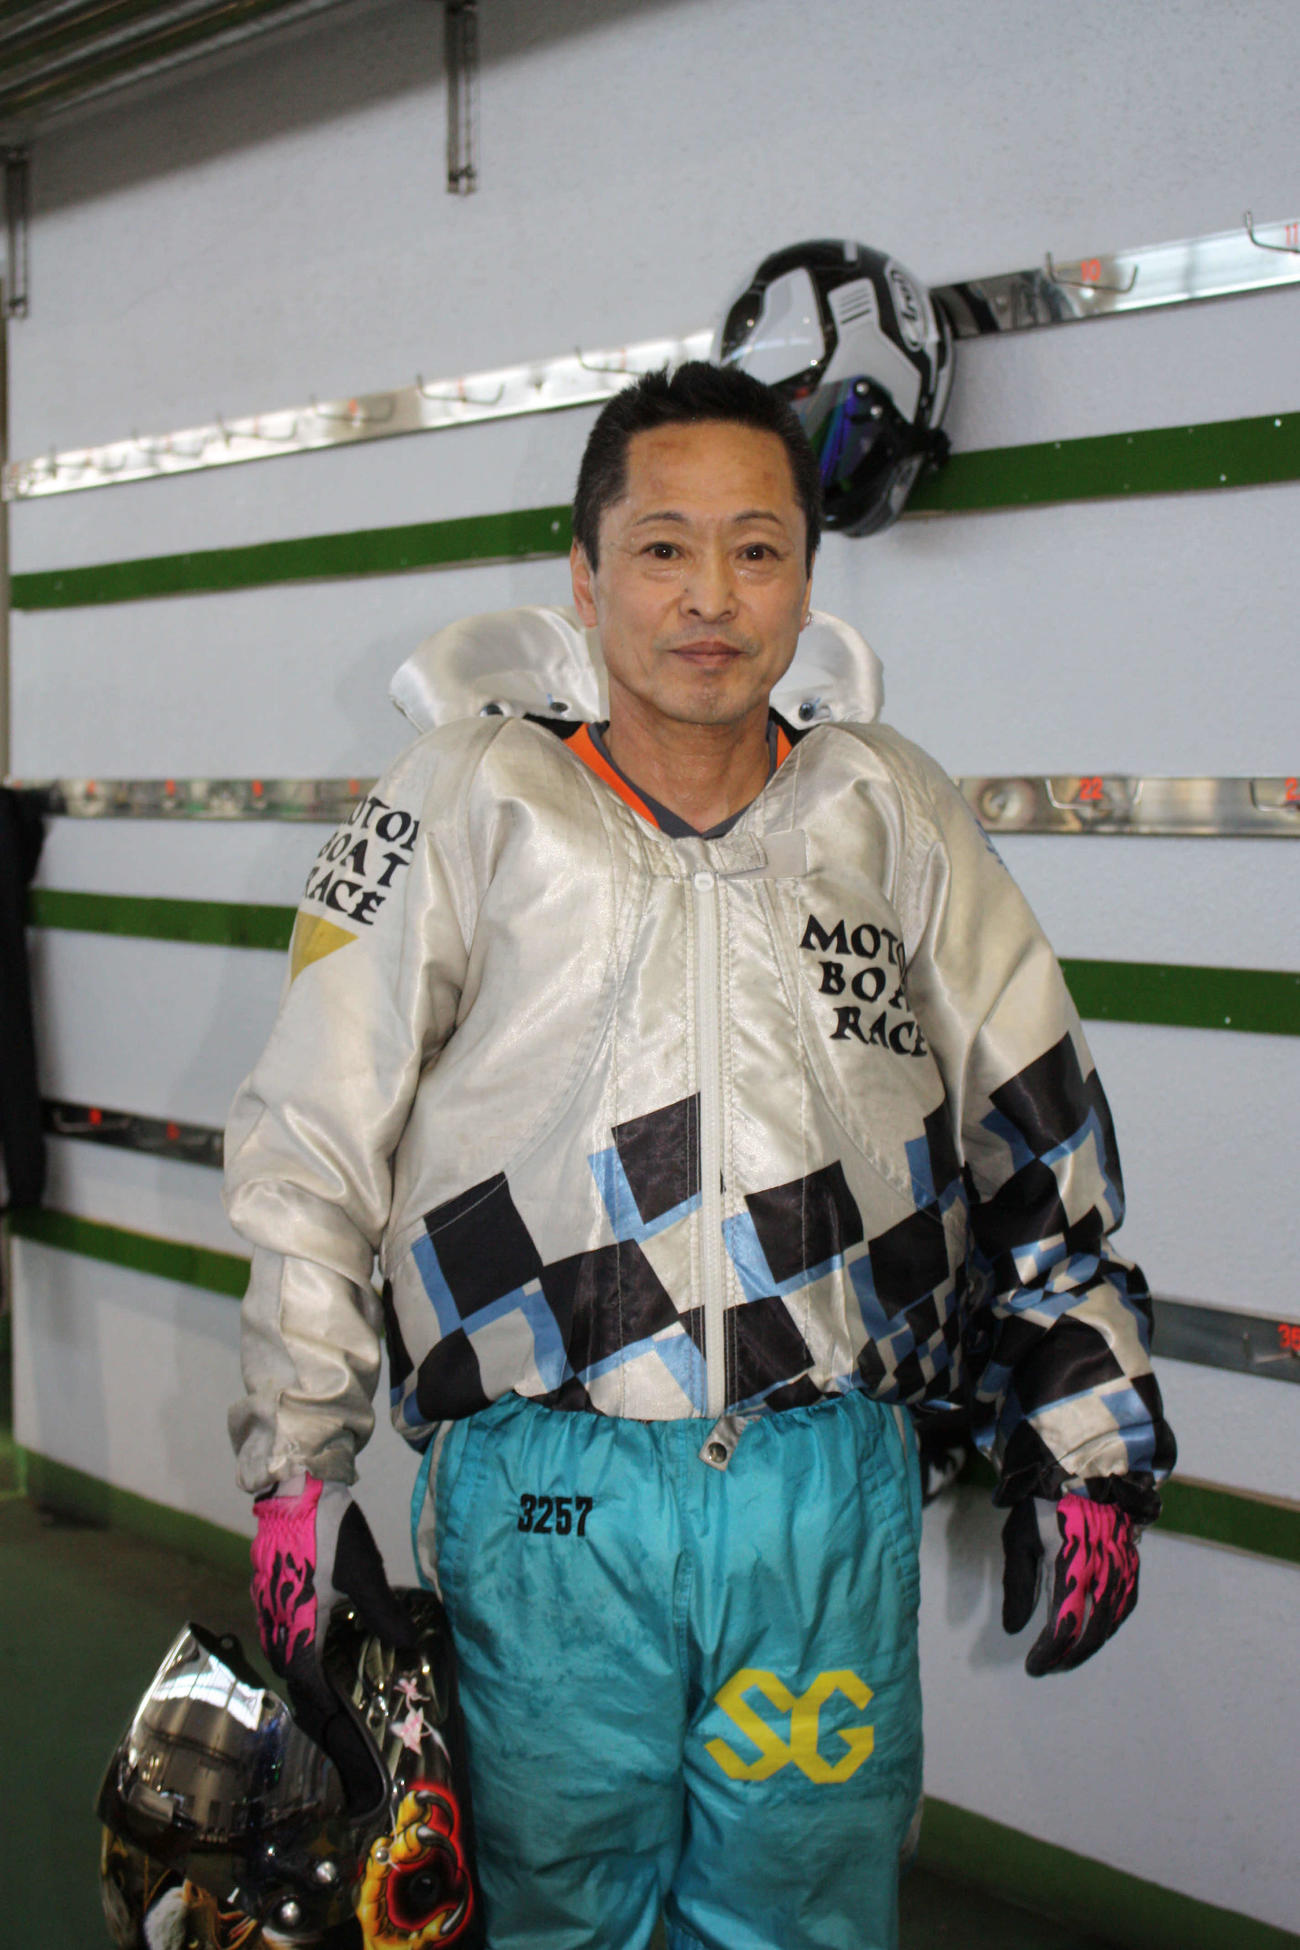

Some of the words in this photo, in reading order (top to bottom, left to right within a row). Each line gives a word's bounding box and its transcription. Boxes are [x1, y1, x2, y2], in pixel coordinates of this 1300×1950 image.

[1080, 259, 1101, 282] 10
[1080, 776, 1104, 800] 22
[1285, 777, 1300, 801] 2
[799, 914, 906, 974] MOTO
[517, 1493, 593, 1537] 3257
[704, 1668, 875, 1784] SG
